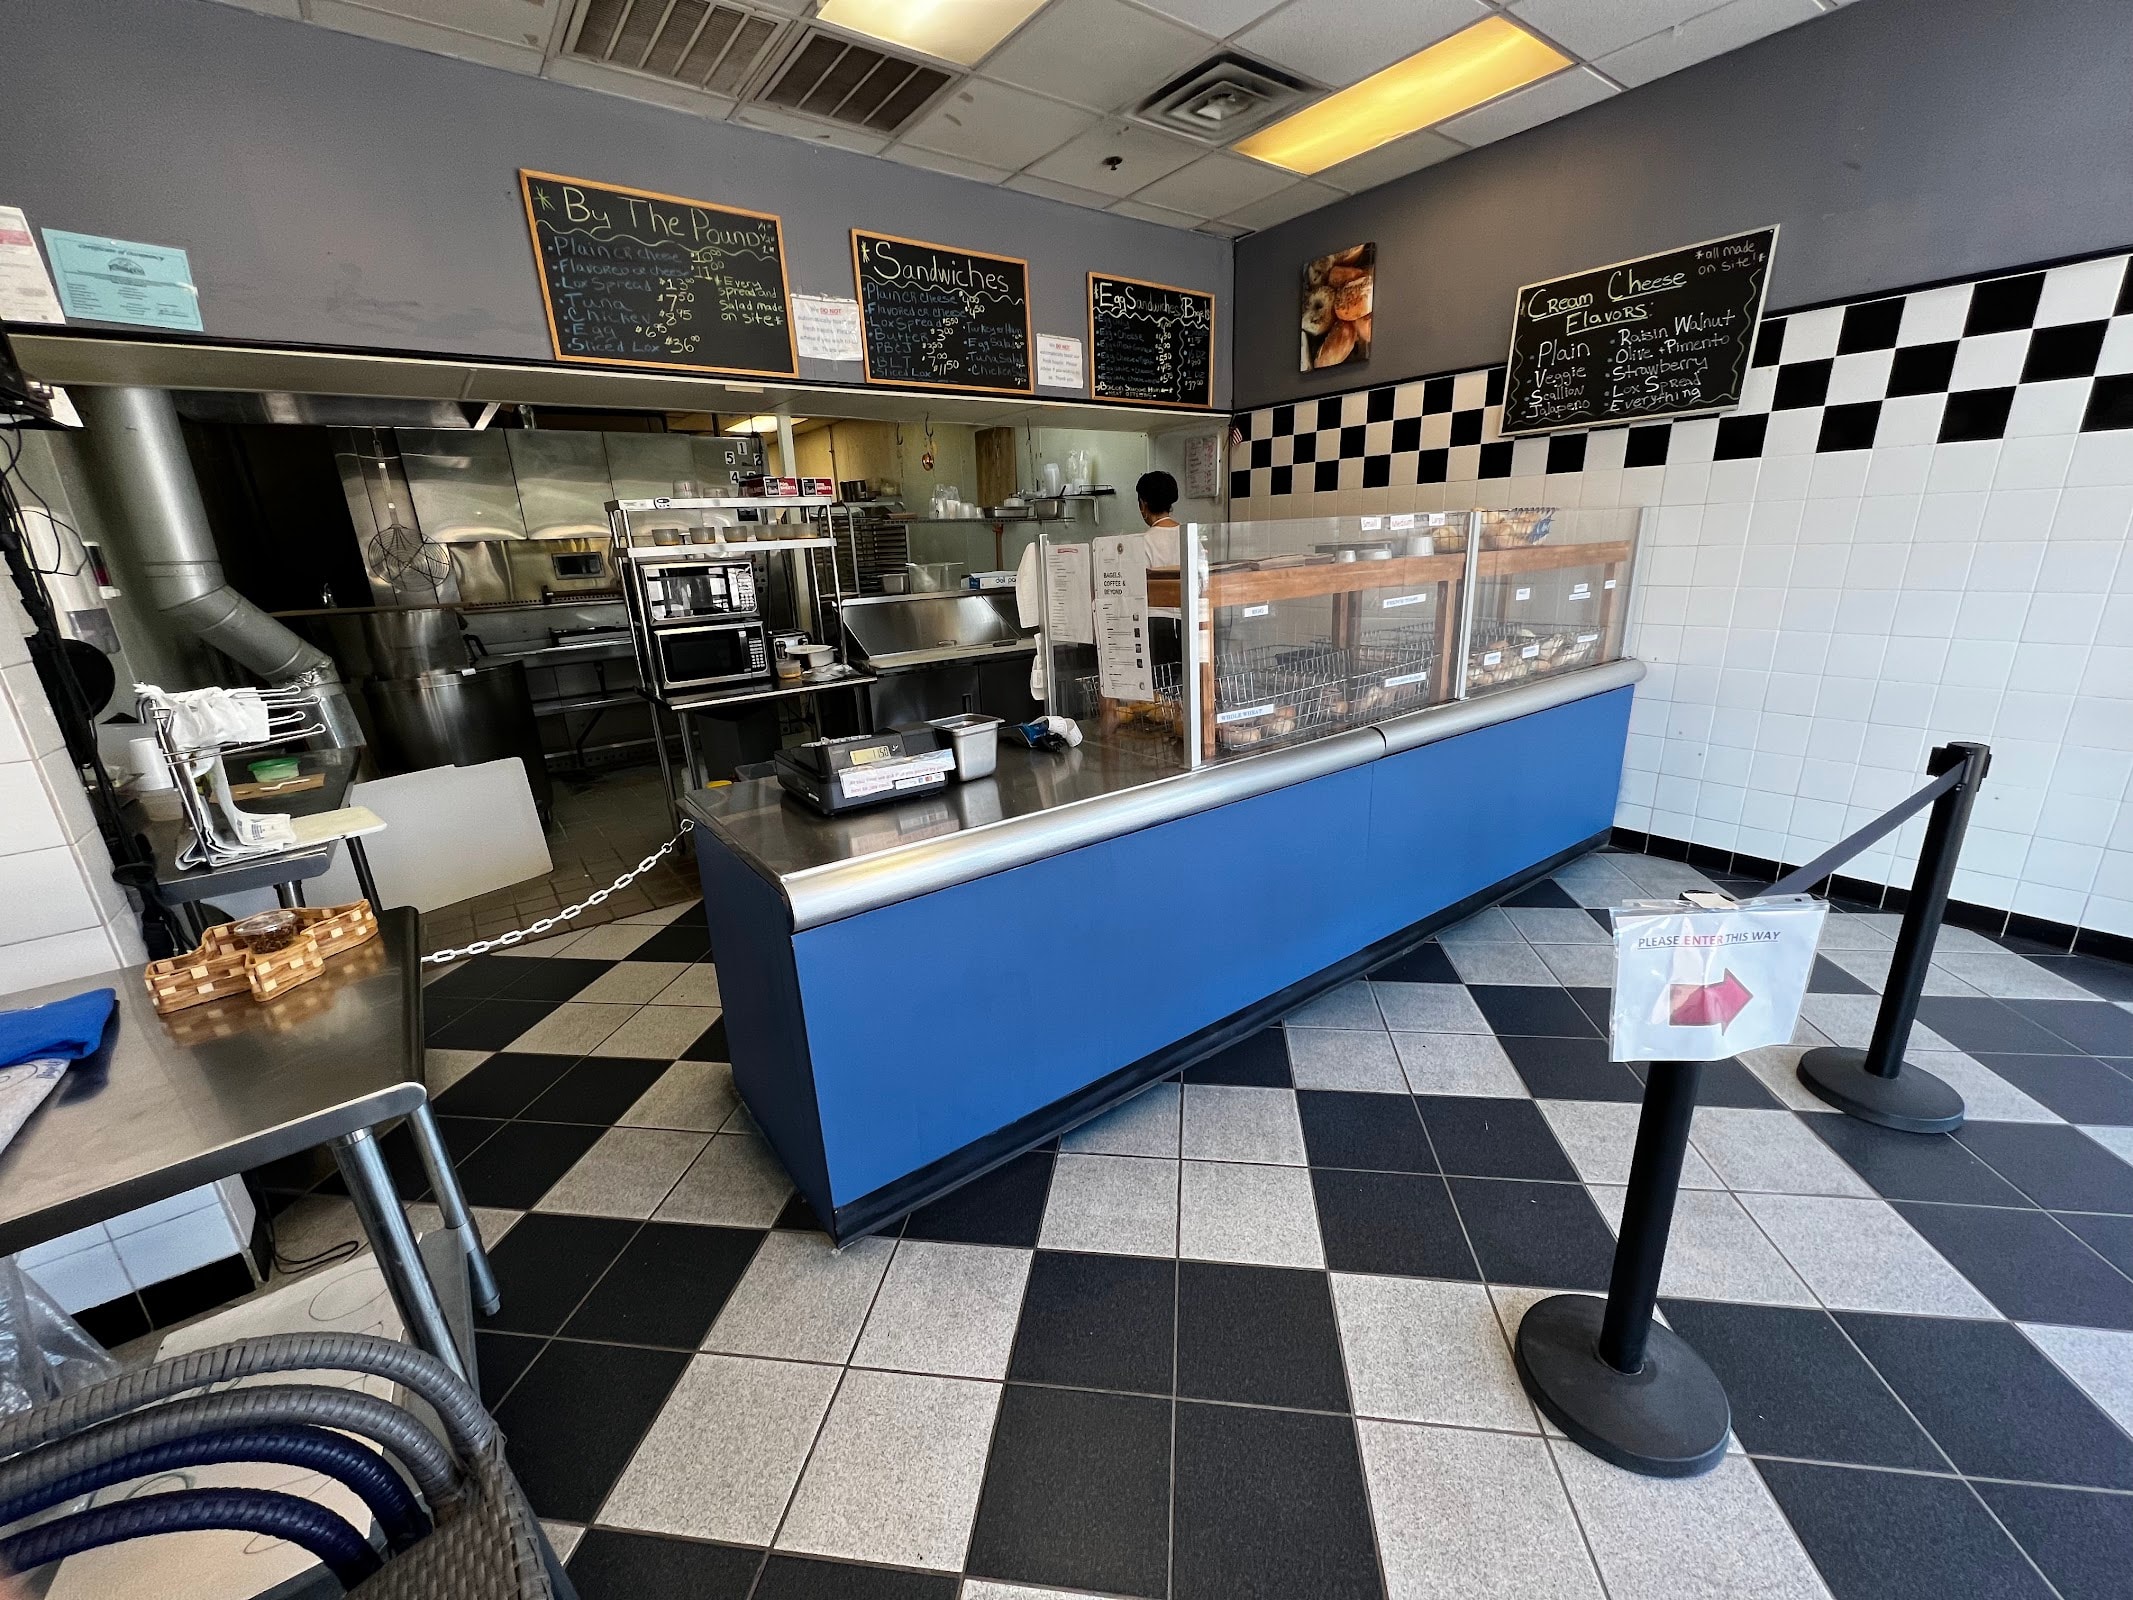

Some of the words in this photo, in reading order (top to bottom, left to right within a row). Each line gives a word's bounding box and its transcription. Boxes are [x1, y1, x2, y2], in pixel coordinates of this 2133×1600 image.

[562, 186, 611, 235] By
[617, 196, 684, 237] The
[554, 236, 611, 259] Plain
[1705, 248, 1720, 260] all
[1722, 241, 1755, 258] made
[874, 241, 1009, 293] Sandwiches
[1698, 263, 1716, 276] on
[560, 276, 588, 290] Lox
[591, 277, 652, 294] Spread
[724, 276, 762, 290] Every
[866, 282, 900, 302] Plain
[1608, 269, 1687, 300] Cheese
[564, 292, 632, 312] Tuna
[758, 288, 777, 298] and
[1100, 282, 1126, 312] Egg
[1125, 286, 1181, 316] Sandwiches
[756, 302, 784, 312] made
[1181, 296, 1210, 324] Bagels
[720, 312, 738, 321] on
[742, 312, 774, 326] site
[870, 316, 894, 328] Lox
[896, 317, 942, 332] Spread
[1618, 327, 1668, 346] Raisin
[1674, 309, 1736, 335] Walnut
[572, 322, 617, 342] Egg
[572, 337, 624, 352] Sliced
[632, 341, 660, 352] Lox
[968, 337, 990, 352] Egg
[1538, 339, 1590, 368] Plain
[1616, 346, 1653, 364] Olive
[1664, 334, 1730, 355] Pimento
[968, 351, 997, 363] Tuna
[998, 352, 1024, 364] Salad
[876, 367, 908, 376] Sliced
[912, 368, 932, 378] Lox
[1534, 366, 1586, 388] Veggie
[1612, 356, 1708, 382] Strawberry
[1610, 386, 1702, 412] Everything
[1612, 384, 1640, 398] Lox
[1525, 400, 1590, 418] Jalapeno
[740, 442, 744, 454] 1
[726, 452, 734, 464] 5
[755, 454, 762, 466] 2
[732, 472, 738, 483] 4
[1221, 712, 1241, 721] WHOLE
[1242, 708, 1262, 716] WHEAT
[1638, 936, 1679, 948] PLEASE
[1684, 935, 1724, 946] ENTER
[1725, 932, 1748, 942] THIS
[1750, 931, 1781, 941] WAY
